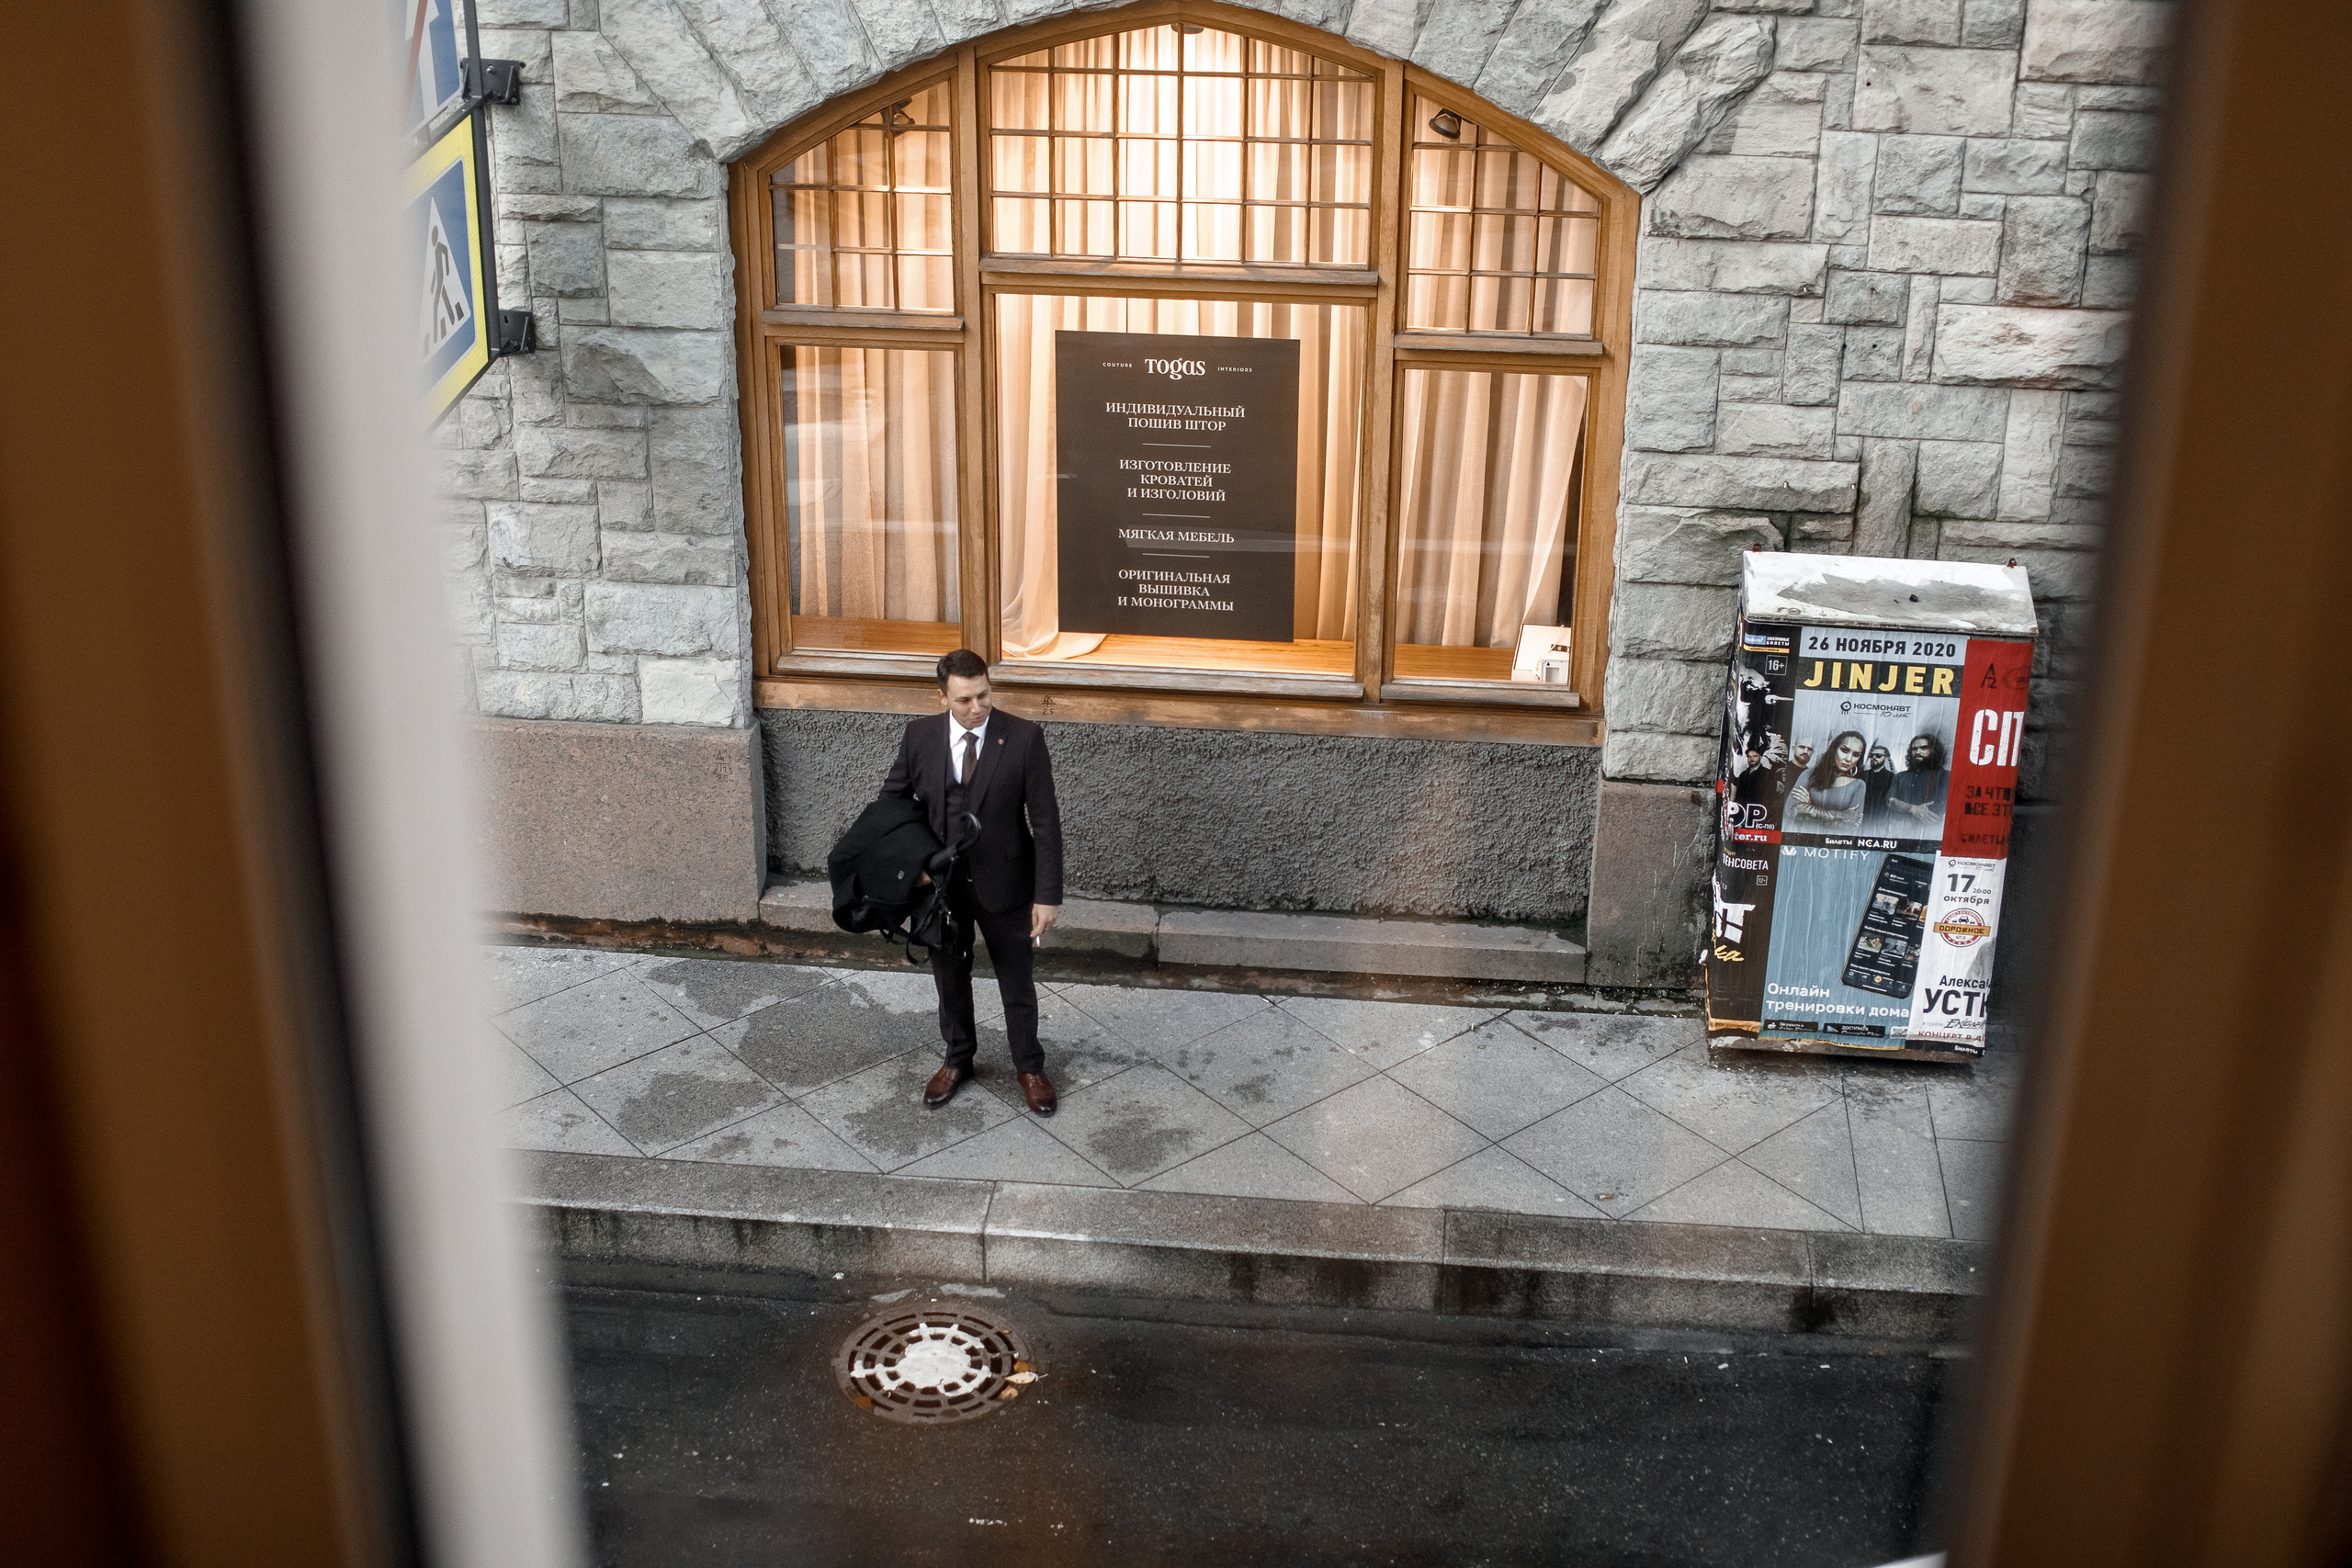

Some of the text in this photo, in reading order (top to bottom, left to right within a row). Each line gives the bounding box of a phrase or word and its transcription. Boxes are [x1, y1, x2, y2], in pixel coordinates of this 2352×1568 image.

[1105, 402, 1246, 418] ИНДИВИДУАЛЬНЫЙ
[1128, 418, 1227, 432] ПОШИВ ШТОР
[1119, 459, 1231, 474] ИЗГОТОВЛЕНИЕ
[1140, 474, 1213, 488] КРОВАТЕЙ
[1127, 488, 1227, 502] И ИЗГОЛОВИЙ
[1118, 528, 1235, 544] МЯГКАЯ МЕБЕЛЬ
[1118, 570, 1230, 584] ОРИГИНАЛЬНАЯ
[1138, 583, 1210, 597] ВЫШИВКА
[1117, 596, 1234, 612] И МОНОГРАММЫ
[1808, 636, 1956, 658] 26 НОЯБРЯ 2020
[1768, 660, 1785, 671] 16+
[1803, 660, 1955, 695] JINJER
[1853, 703, 1912, 713] КОСМОНАВТ
[1966, 785, 1982, 799] ЗА
[1825, 837, 1898, 849] Билеты NCA.RU
[1804, 848, 1871, 861] MOTIFY
[1947, 874, 1976, 893] 17
[1943, 896, 1990, 906] октября
[1939, 925, 1985, 935] ДОРОЖНОЕ
[1767, 982, 1830, 998] Онлайн
[1766, 999, 1910, 1018] тренировки дома
[1917, 1031, 1962, 1040] КОНЦЕРТ
[1954, 1044, 1978, 1055] Билеты
